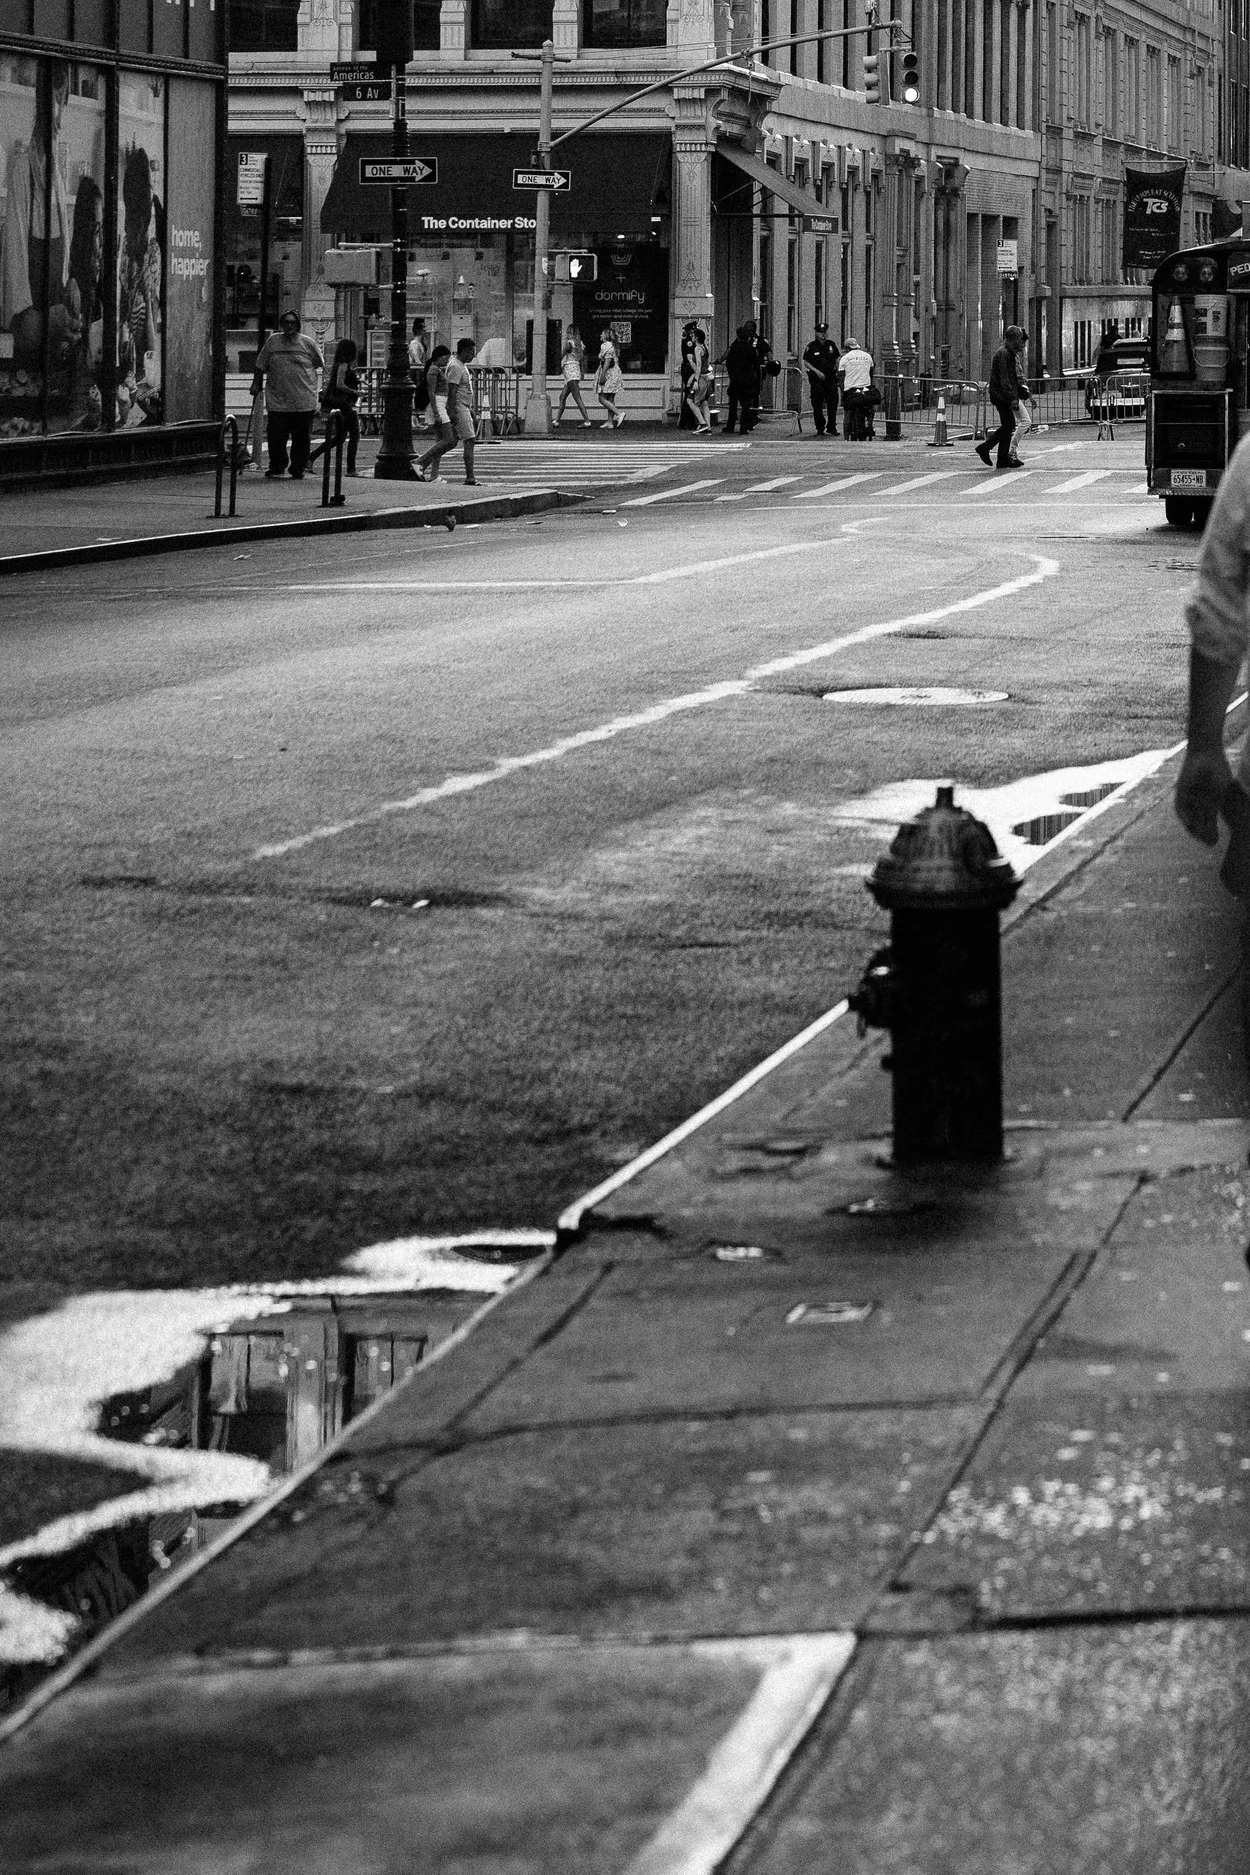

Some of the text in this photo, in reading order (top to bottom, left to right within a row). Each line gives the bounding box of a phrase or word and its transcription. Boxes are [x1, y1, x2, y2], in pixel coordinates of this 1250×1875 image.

[333, 70, 375, 80] Americas
[355, 87, 379, 99] 6 Av
[241, 154, 247, 165] 3
[371, 166, 425, 176] ONE WAY
[545, 176, 562, 184] WAY
[421, 216, 537, 229] The Container Sto
[171, 224, 202, 251] home,
[171, 252, 210, 280] happier
[595, 289, 645, 304] dormify
